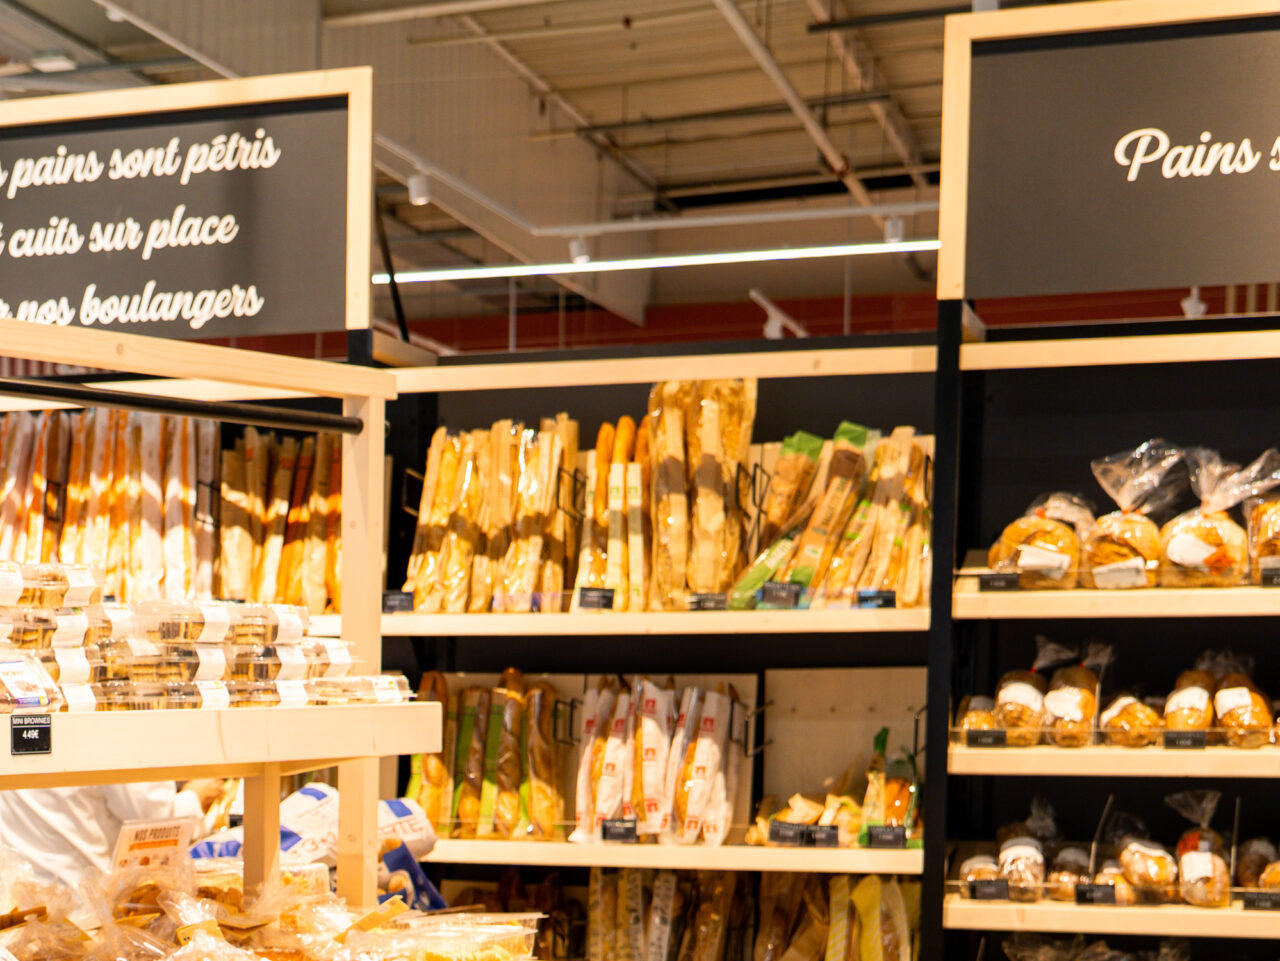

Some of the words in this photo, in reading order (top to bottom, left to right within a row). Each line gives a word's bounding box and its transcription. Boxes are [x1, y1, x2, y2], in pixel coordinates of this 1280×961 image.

[7, 145, 104, 199] pains
[109, 137, 181, 180] sont
[180, 128, 281, 185] pétris
[1114, 127, 1262, 182] Pains
[9, 216, 84, 258] cuits
[89, 217, 143, 252] sur
[142, 204, 239, 260] place
[16, 296, 75, 326] nos
[80, 280, 264, 329] boulangers
